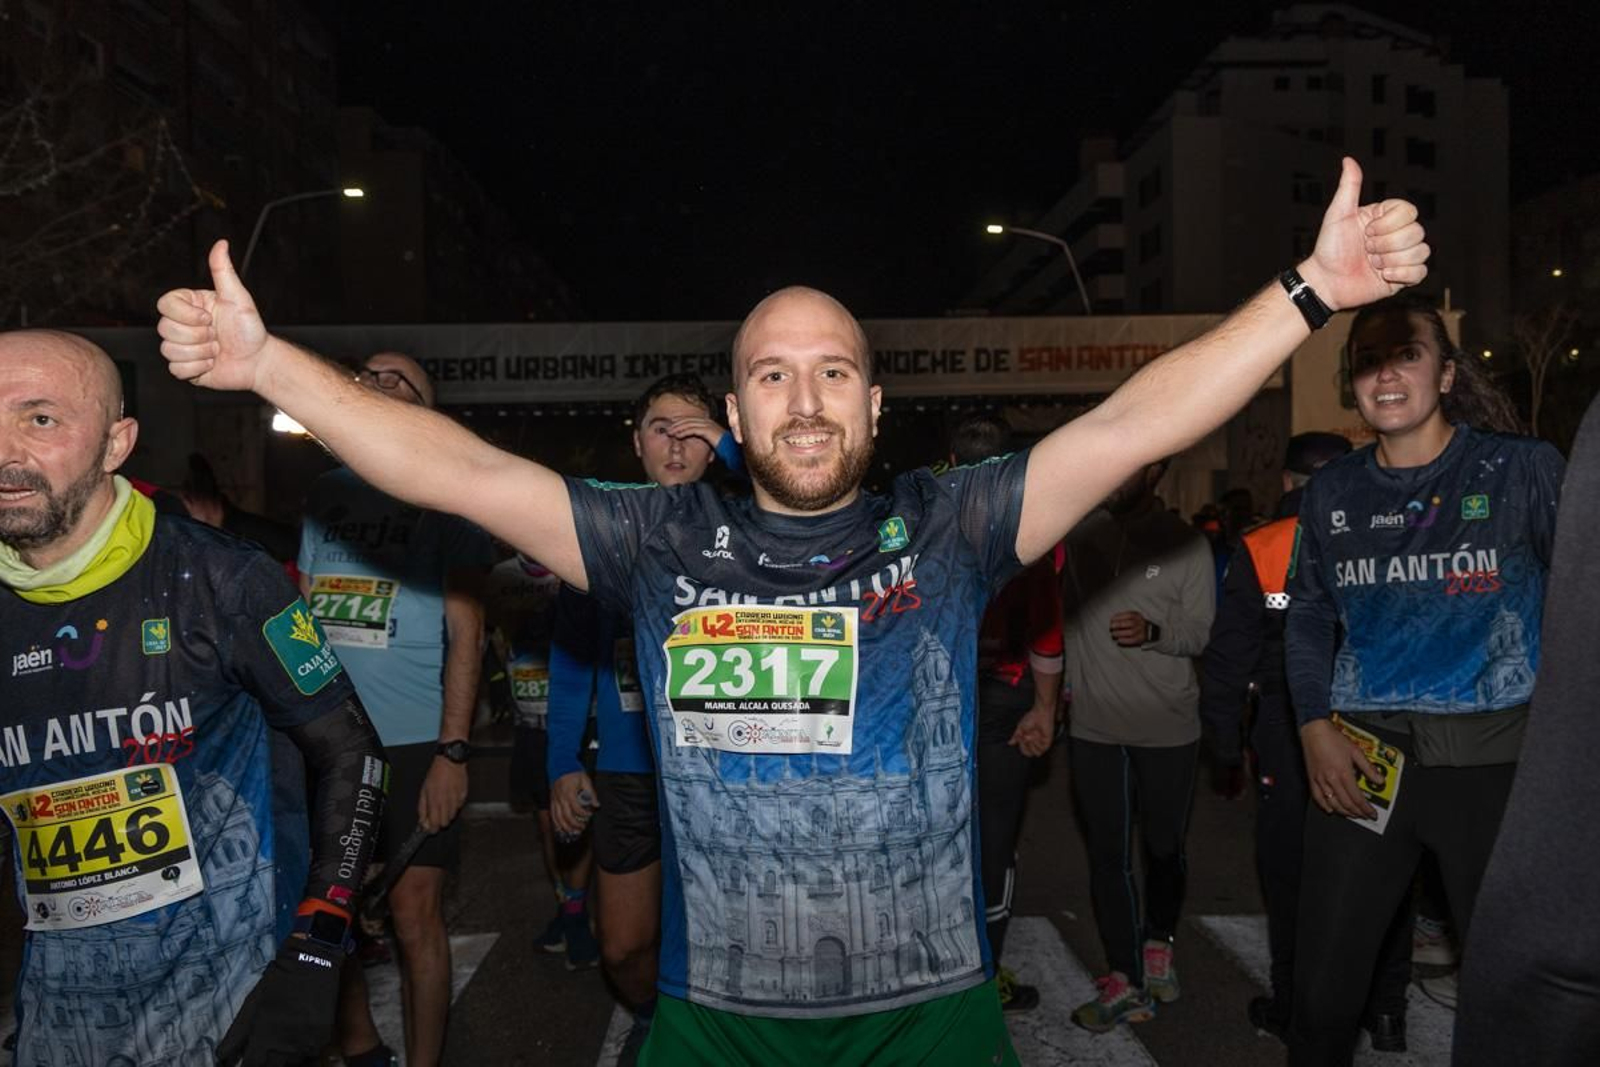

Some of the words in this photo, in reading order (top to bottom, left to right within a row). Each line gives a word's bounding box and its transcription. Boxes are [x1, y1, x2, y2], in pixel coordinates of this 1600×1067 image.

[424, 358, 496, 380] RERA
[505, 355, 615, 380] URBANA
[623, 352, 731, 378] INTERN
[875, 349, 966, 374] NOCHE
[974, 348, 1009, 372] DE
[1019, 347, 1072, 371] SAN
[1336, 558, 1376, 587] SAN
[1386, 543, 1498, 583] ANTÓN
[1444, 569, 1502, 596] 2025
[311, 593, 384, 621] 2714
[702, 613, 736, 638] 42
[736, 624, 760, 635] SAN
[762, 624, 804, 635] ANTON
[297, 655, 324, 677] CAJA
[680, 647, 839, 697] 2317
[516, 680, 549, 697] 287
[705, 702, 737, 710] MANUEL
[739, 702, 769, 710] ALCALA
[771, 702, 810, 710] QUESADA
[44, 692, 193, 760] ANTÓN
[355, 788, 376, 823] del
[27, 806, 170, 876] 4446
[338, 817, 371, 880] Lagarto
[104, 866, 139, 880] BLANCA
[298, 952, 332, 969] KIPRUN
